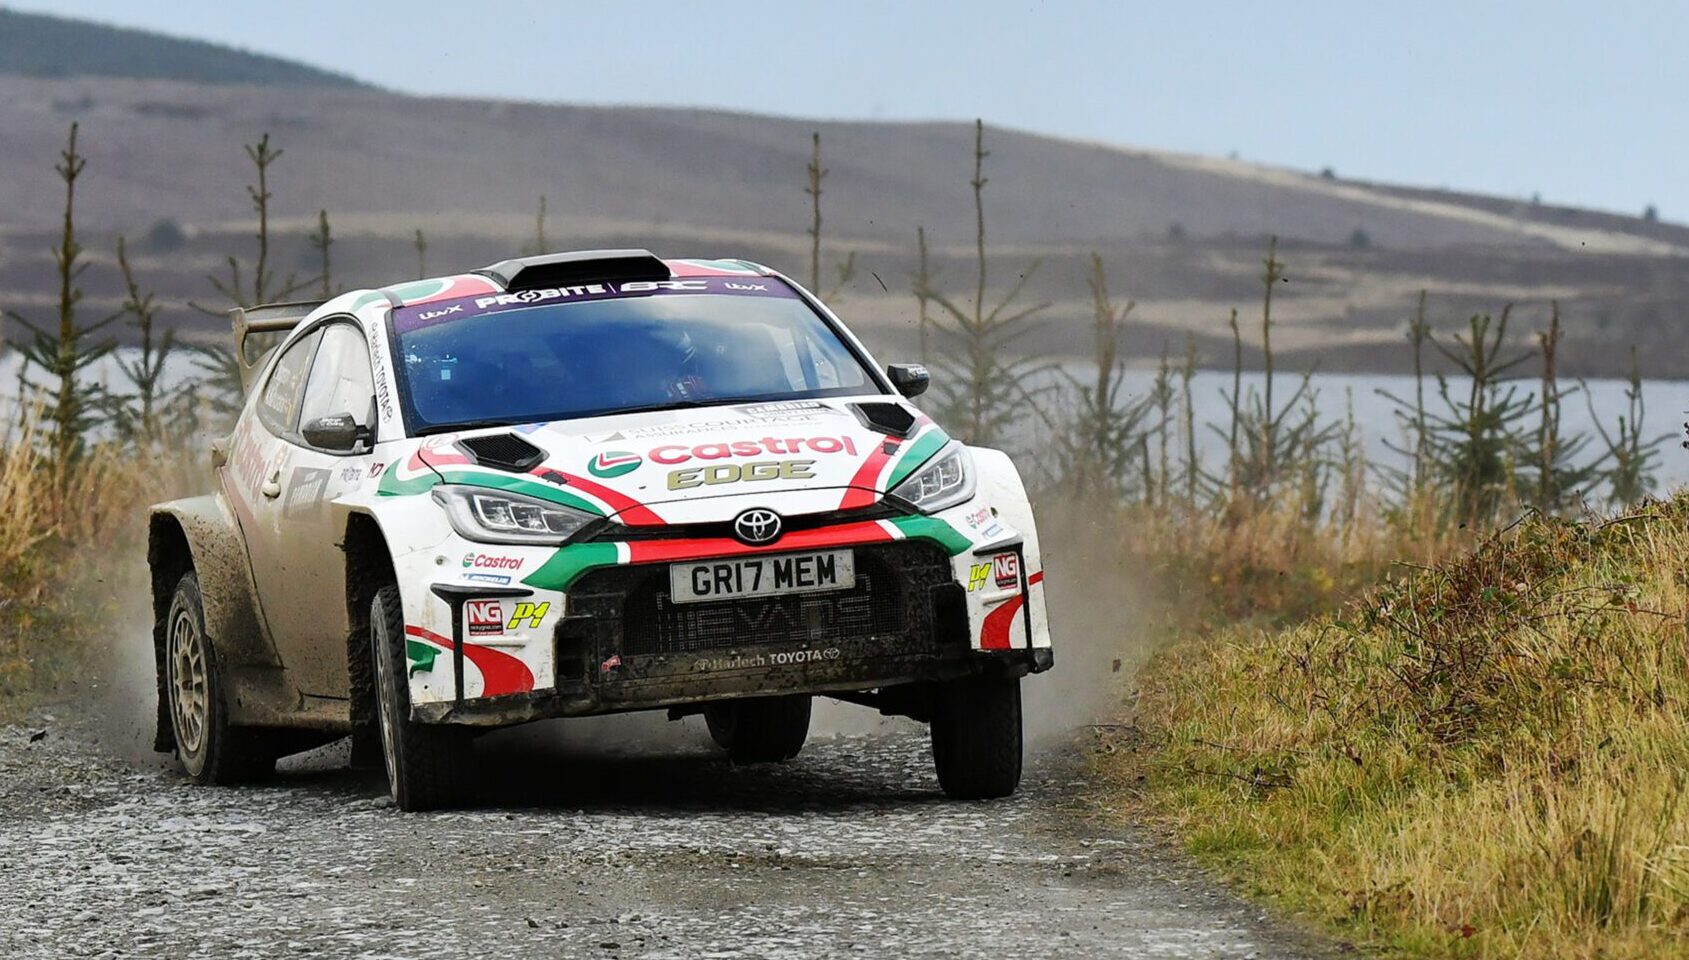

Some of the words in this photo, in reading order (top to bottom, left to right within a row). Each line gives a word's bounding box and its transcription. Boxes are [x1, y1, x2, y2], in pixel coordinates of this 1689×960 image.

[475, 285, 606, 309] PROBITE
[376, 365, 391, 411] TOYOTA
[648, 435, 857, 464] Castrol
[667, 460, 818, 491] EDGE
[474, 554, 524, 570] Castrol
[994, 556, 1017, 579] NG
[691, 561, 763, 596] GR17
[773, 554, 836, 589] MEM
[468, 602, 501, 622] NG
[769, 649, 823, 665] TOYOTA
